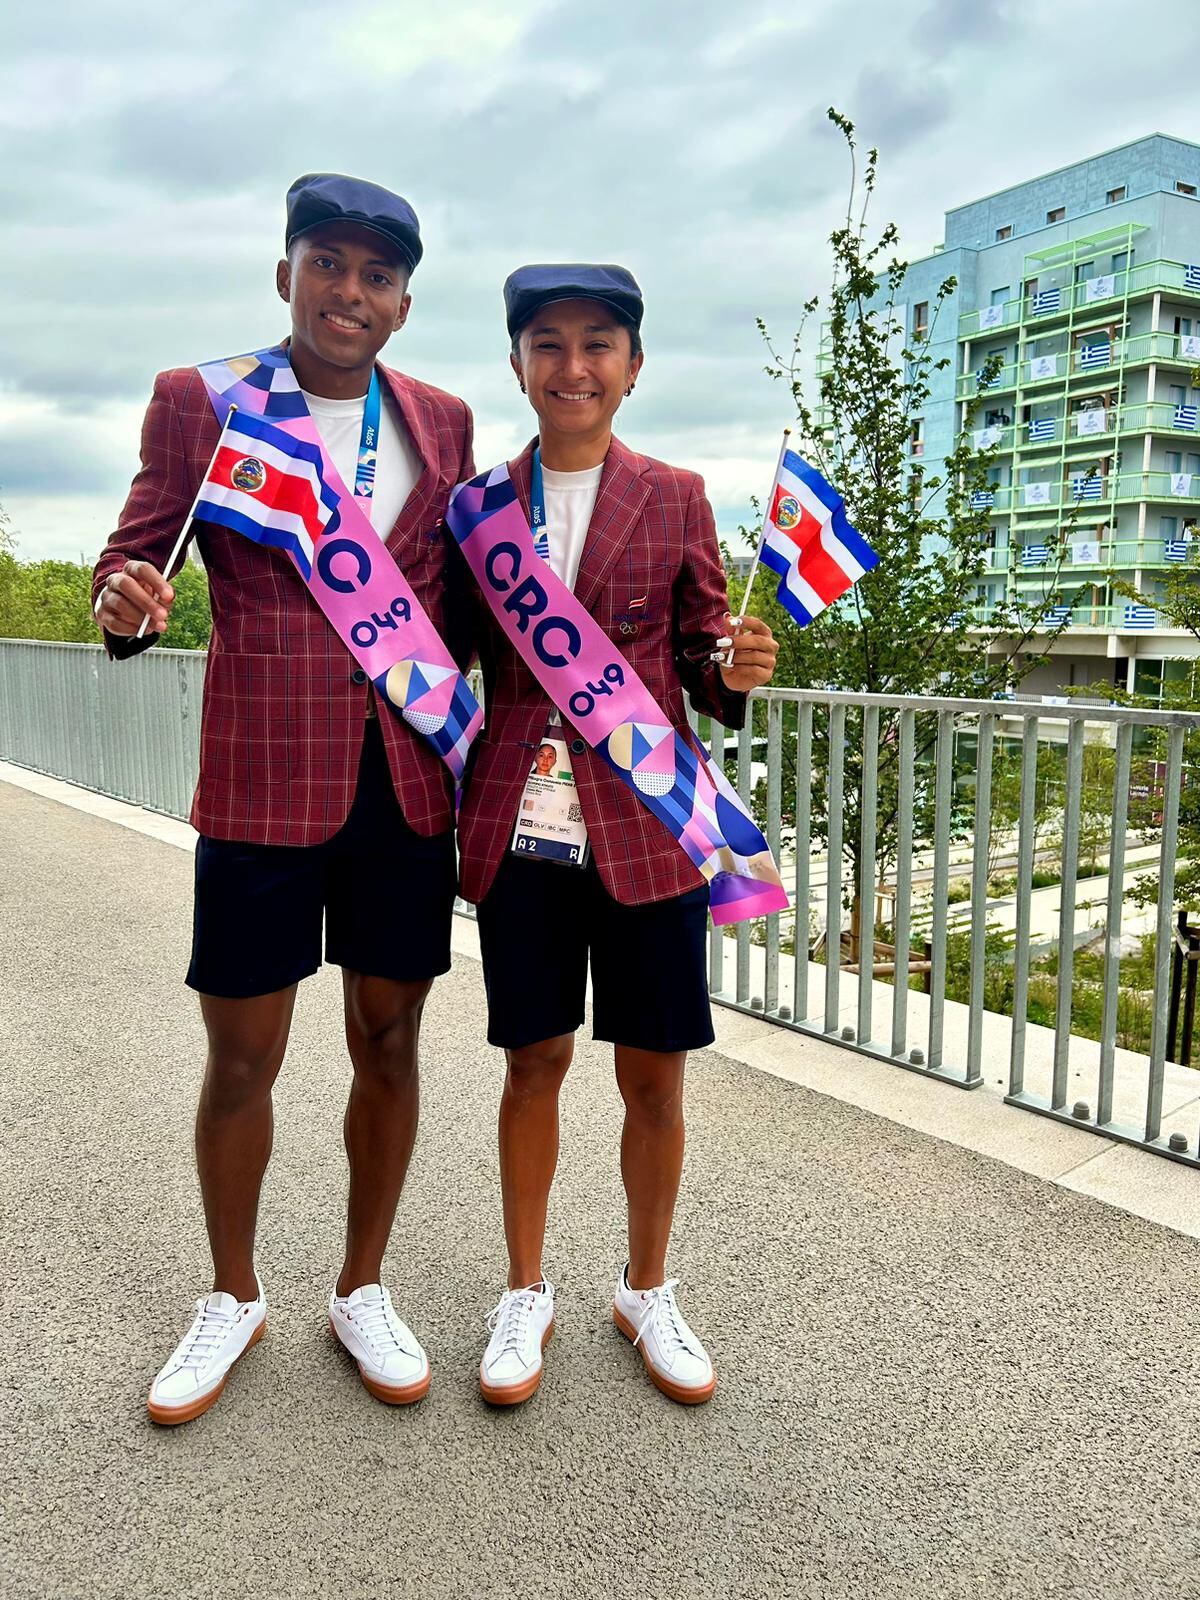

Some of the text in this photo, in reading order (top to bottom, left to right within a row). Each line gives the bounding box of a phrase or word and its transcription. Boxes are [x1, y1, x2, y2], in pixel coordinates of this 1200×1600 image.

[351, 597, 412, 648] 049
[485, 541, 582, 668] CRC
[568, 663, 625, 717] 049
[569, 848, 578, 859] R
